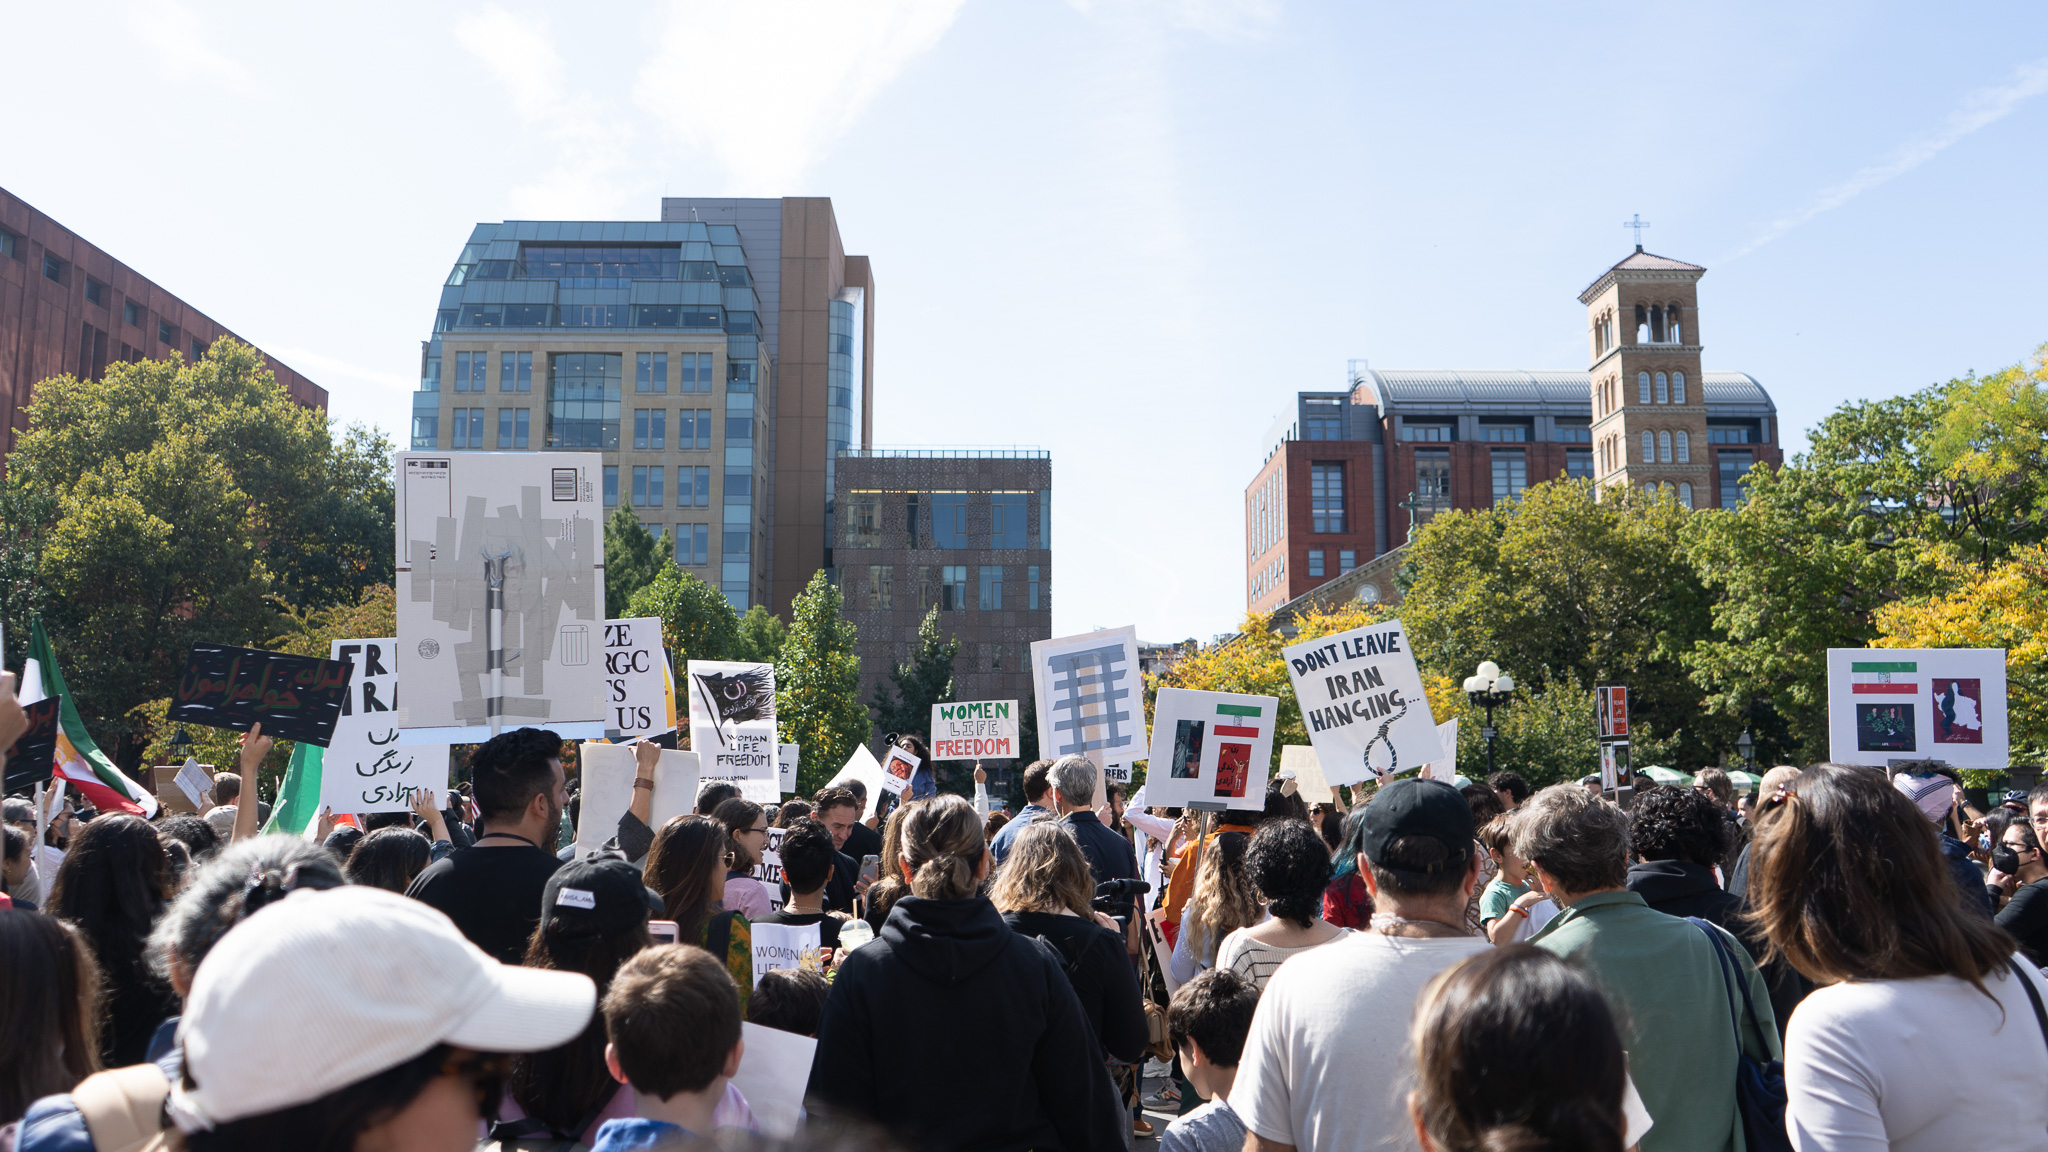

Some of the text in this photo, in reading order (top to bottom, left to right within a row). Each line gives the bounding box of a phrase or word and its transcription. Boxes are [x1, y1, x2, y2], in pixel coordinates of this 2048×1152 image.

[604, 624, 633, 648] ZE
[338, 644, 399, 678] FR
[605, 650, 650, 675] RGC
[1291, 631, 1401, 677] DONT LEAVE
[1325, 666, 1385, 701] IRAN
[341, 681, 398, 717] IR
[615, 706, 652, 730] US
[940, 702, 1010, 721] WOMEN
[949, 720, 999, 737] LIFE
[935, 737, 1011, 757] FREEDOM
[355, 749, 414, 777] زندگی
[716, 753, 771, 768] FREEDOM
[1103, 767, 1128, 781] BERS
[755, 945, 799, 961] WOMEN
